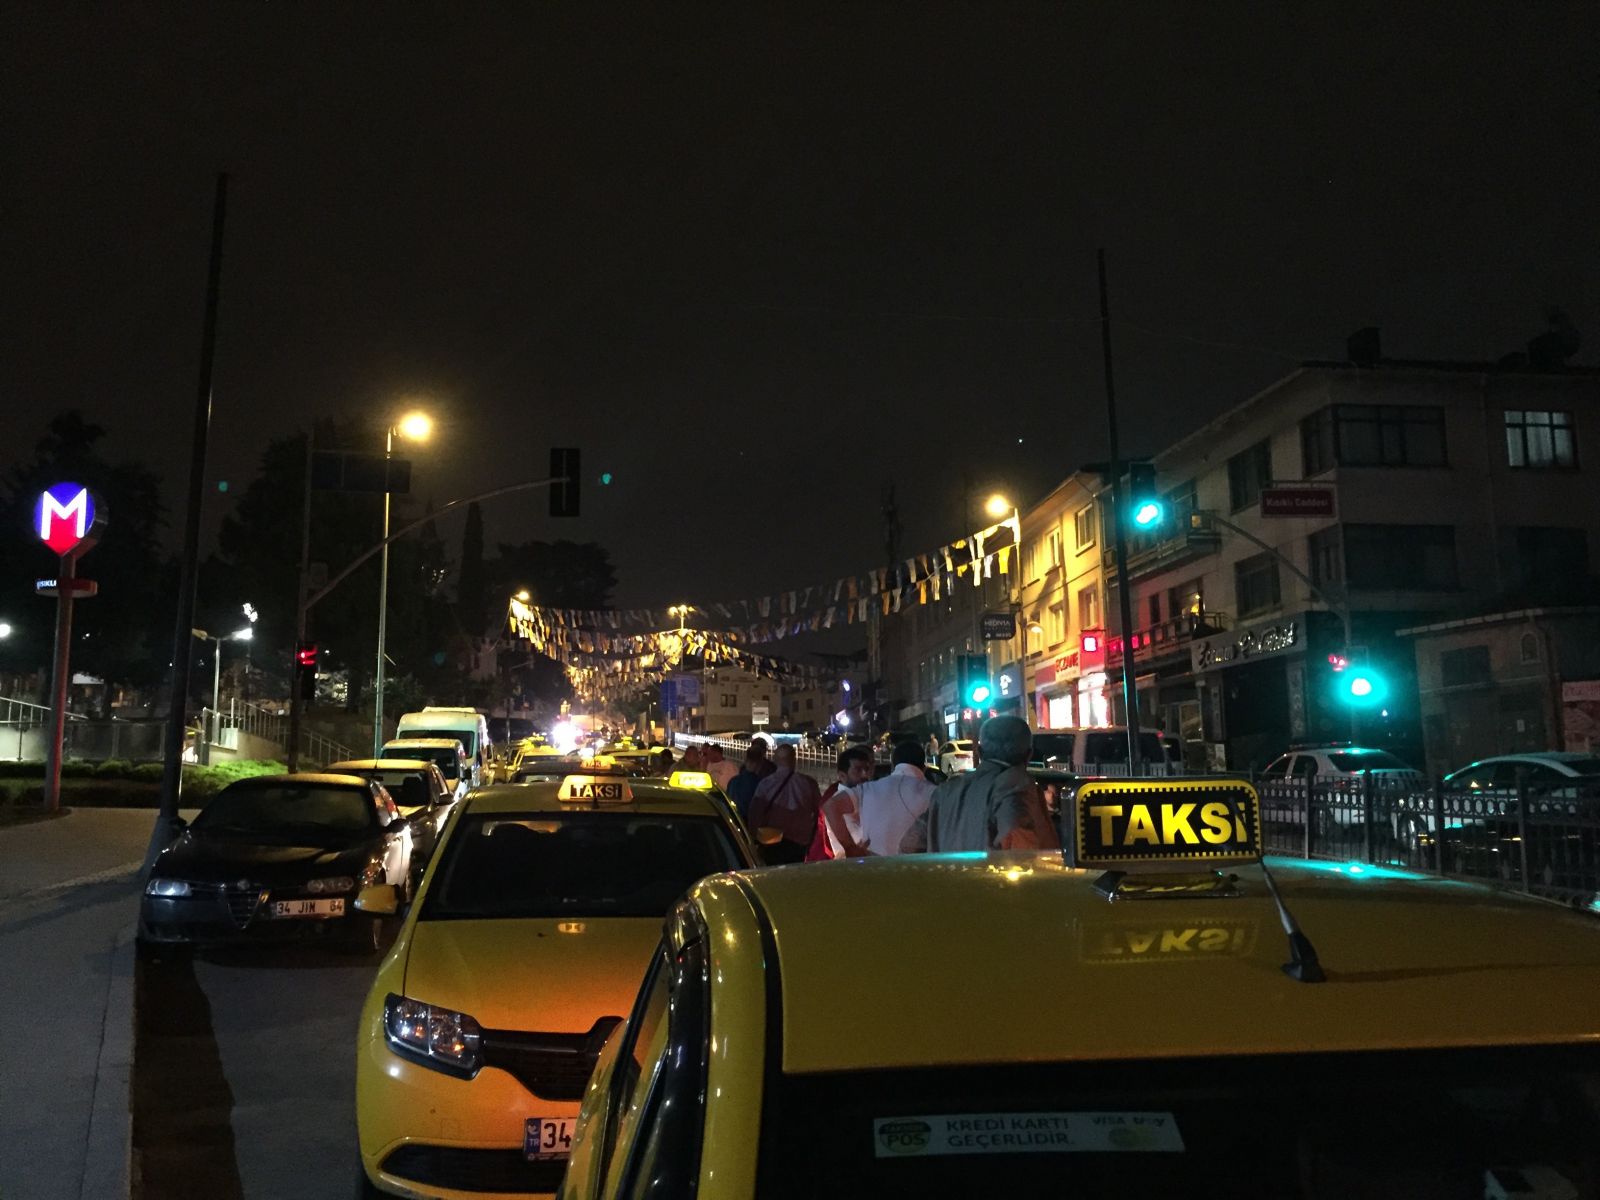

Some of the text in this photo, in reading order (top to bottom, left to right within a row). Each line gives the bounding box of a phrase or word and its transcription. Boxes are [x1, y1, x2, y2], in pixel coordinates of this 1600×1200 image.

[41, 488, 87, 540] M
[278, 902, 290, 914] 34
[544, 1122, 571, 1148] 34
[887, 1134, 926, 1147] POS
[528, 1138, 540, 1147] TR
